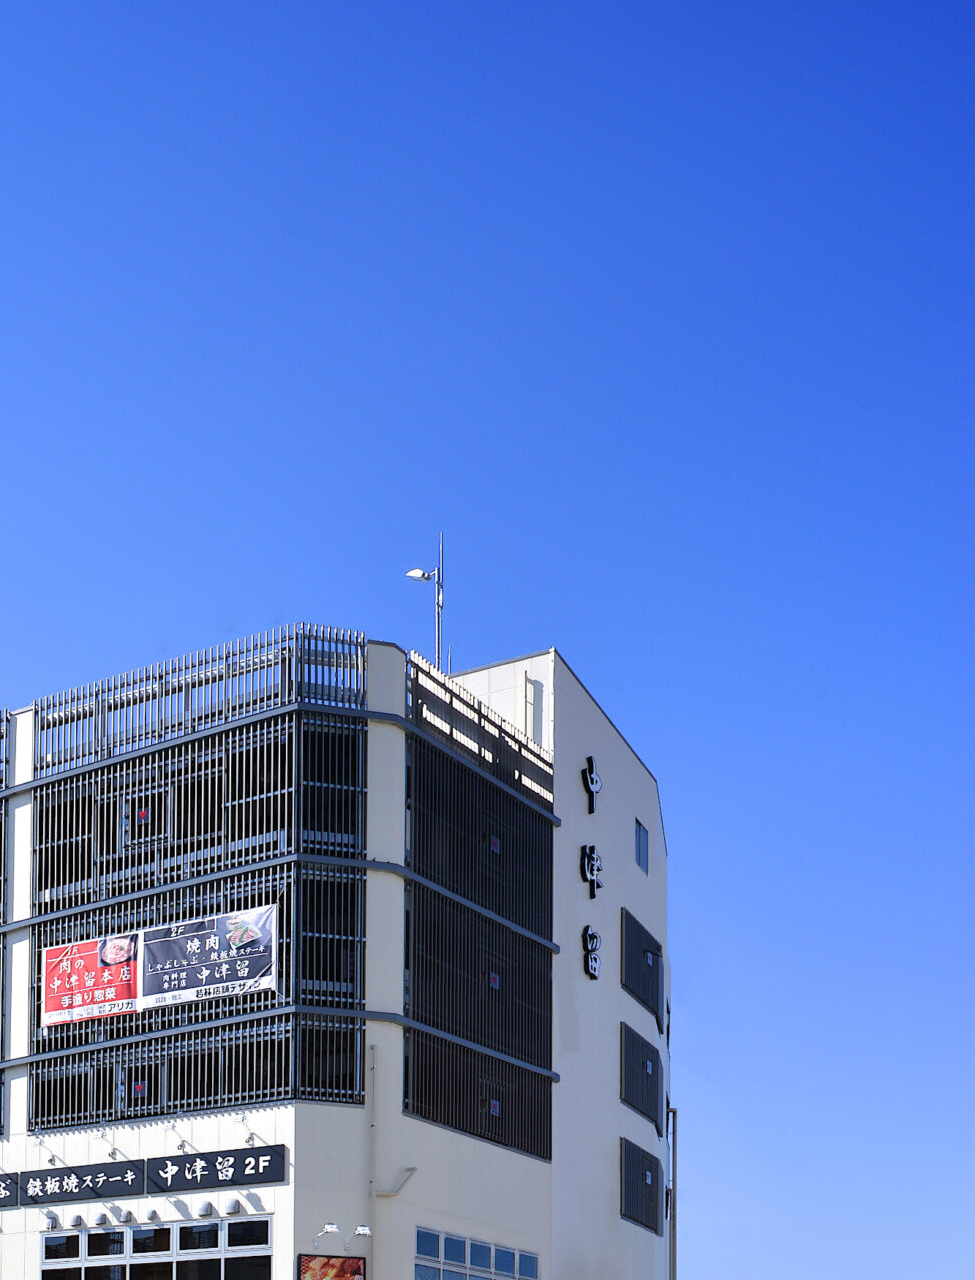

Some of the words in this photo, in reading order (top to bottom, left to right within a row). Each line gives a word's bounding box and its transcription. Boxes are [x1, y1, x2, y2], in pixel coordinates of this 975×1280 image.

[580, 755, 603, 980] 中津留
[170, 926, 185, 937] 2F
[186, 934, 220, 955] 焼肉
[59, 959, 84, 974] 肉の
[196, 960, 250, 985] 中津留
[50, 966, 131, 994] 中津留本店
[61, 987, 116, 1007] 手造り惣菜
[26, 1170, 136, 1197] 鉄板焼ステーキ
[158, 1156, 235, 1188] 中津留
[244, 1155, 271, 1175] 2F
